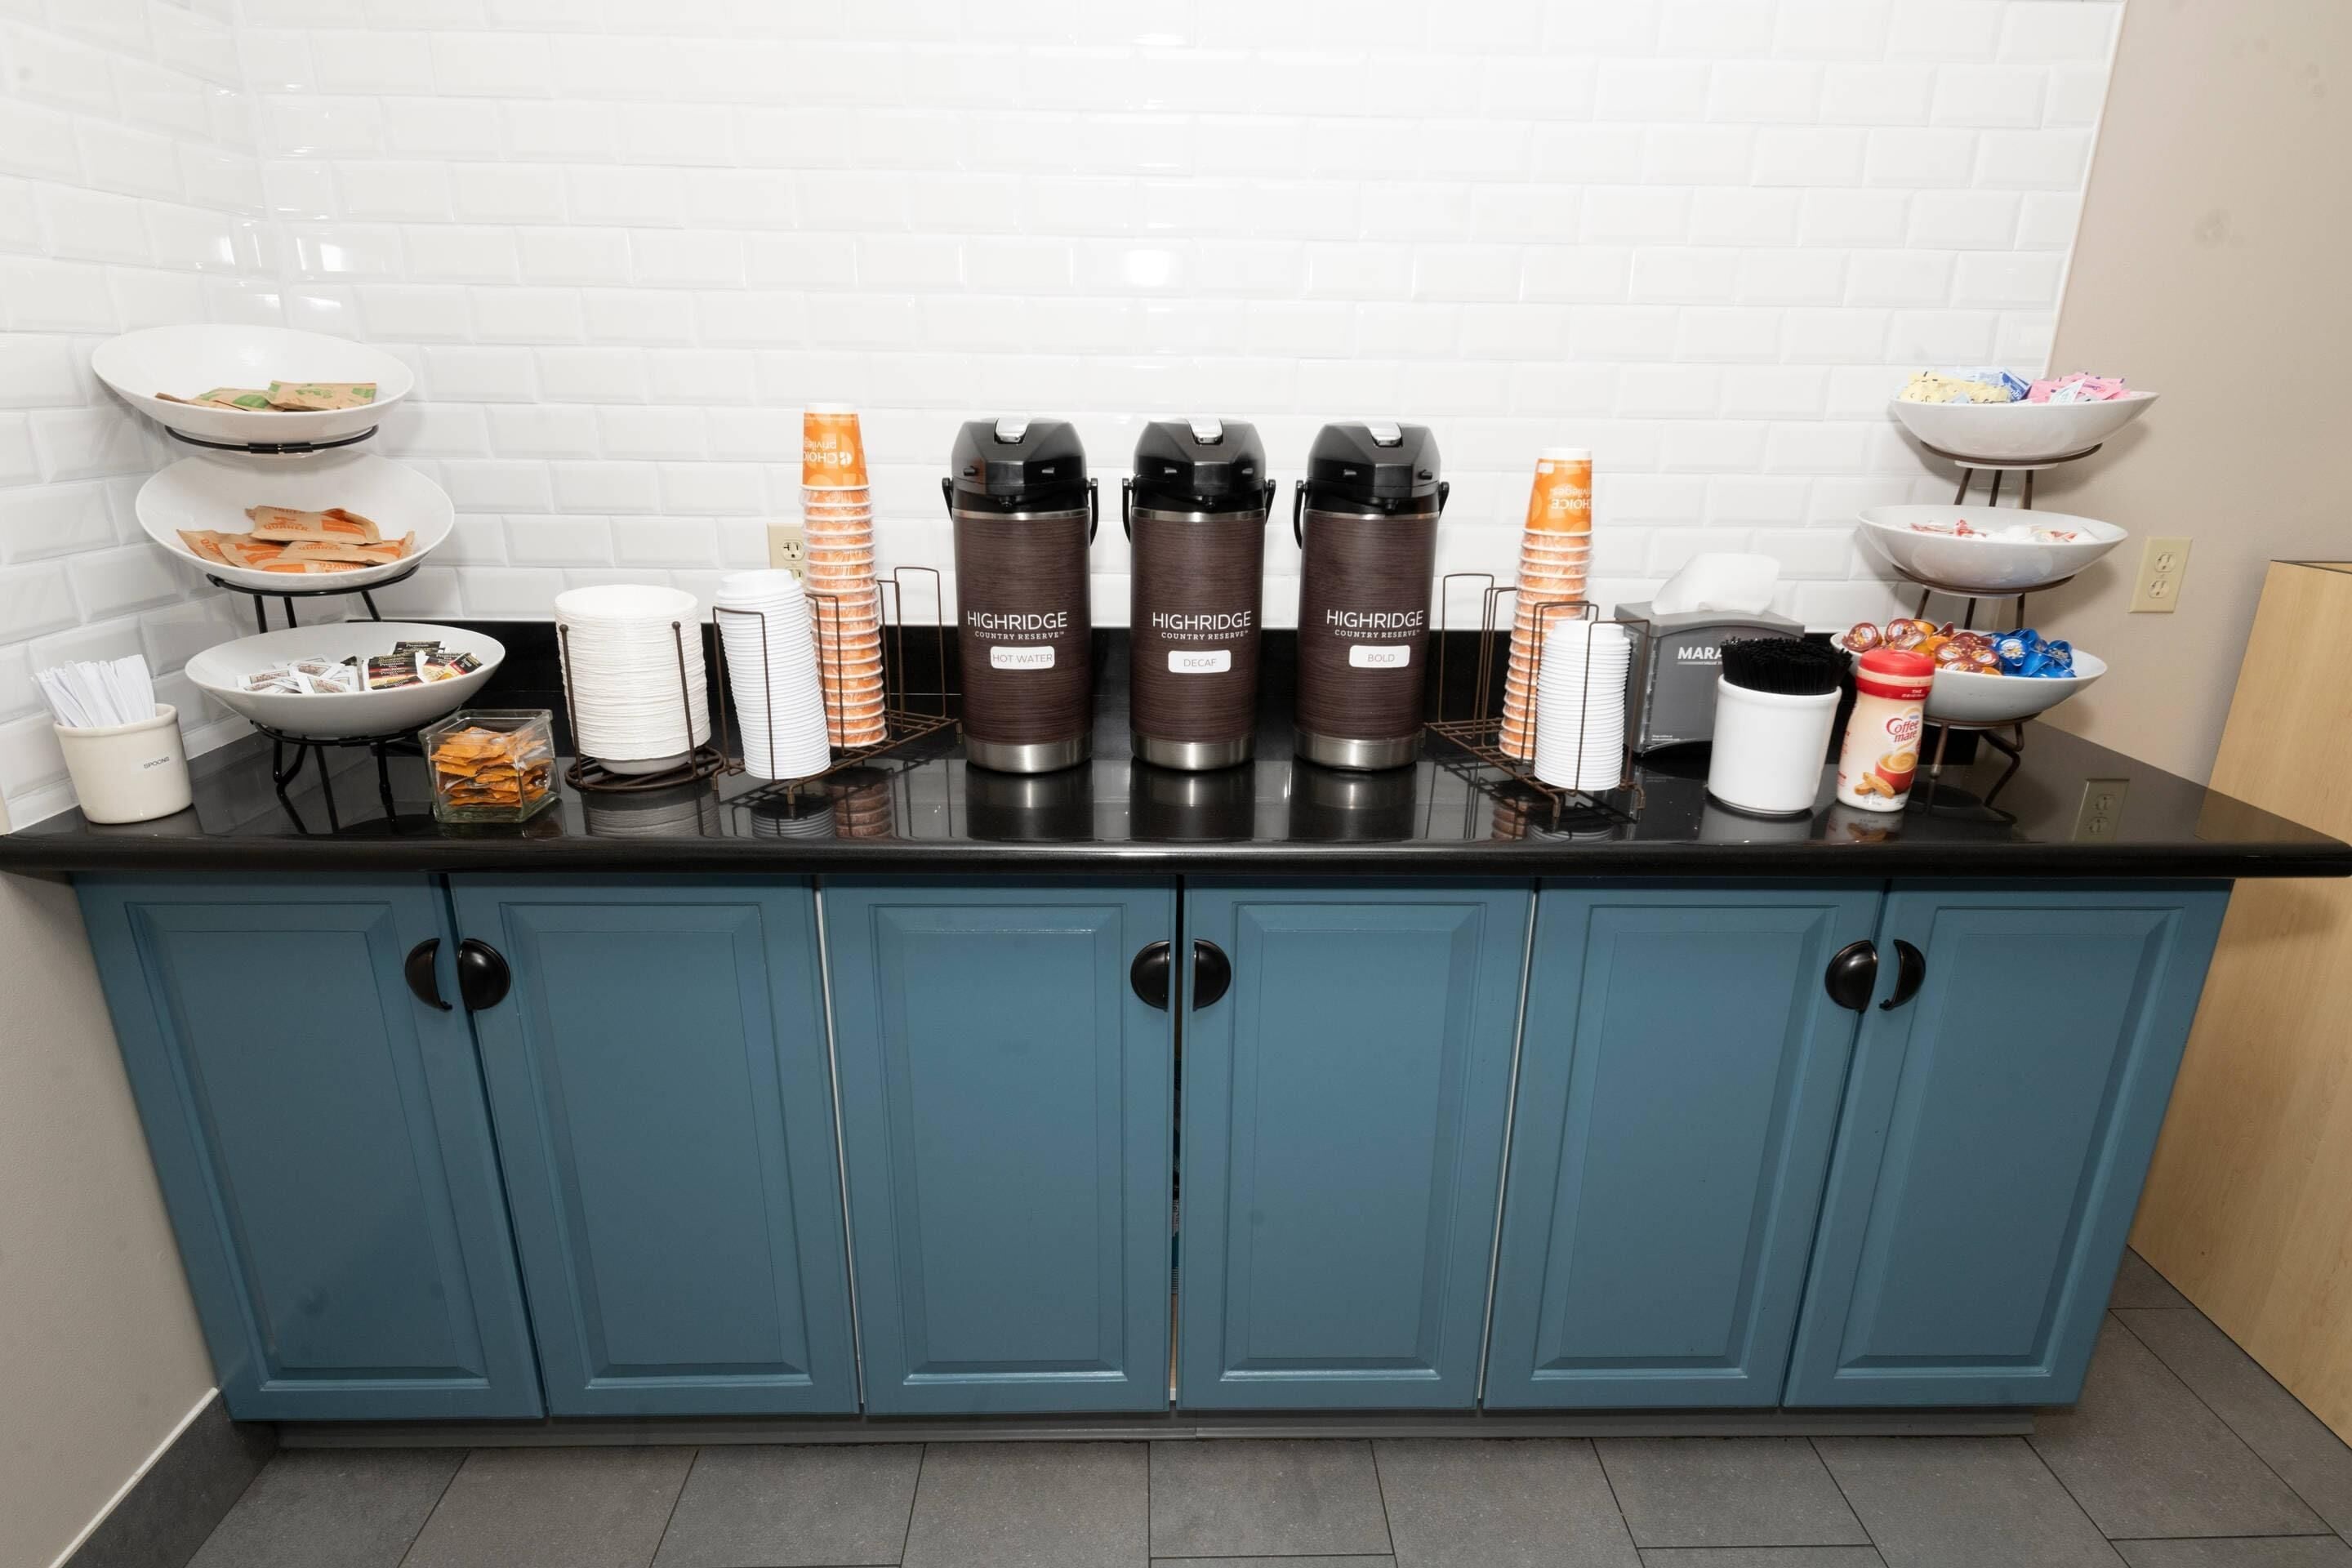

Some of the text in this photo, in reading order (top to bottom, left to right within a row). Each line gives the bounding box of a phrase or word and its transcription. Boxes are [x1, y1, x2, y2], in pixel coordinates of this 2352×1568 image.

[967, 611, 1067, 630] HIGHRIDGE
[1152, 611, 1251, 630] HIGHRIDGE
[1326, 609, 1423, 628] HIGHRIDGE
[974, 630, 1014, 639] COUNTRY
[1161, 632, 1205, 640] COUNTRY
[1334, 629, 1379, 638] COUNTRY
[992, 653, 1053, 663] HOT WATER
[1183, 658, 1217, 667] DECAF
[1367, 653, 1396, 662] BOLD
[1886, 717, 1919, 735] Coffee
[1894, 730, 1918, 743] mate
[144, 756, 170, 768] SPOONS
